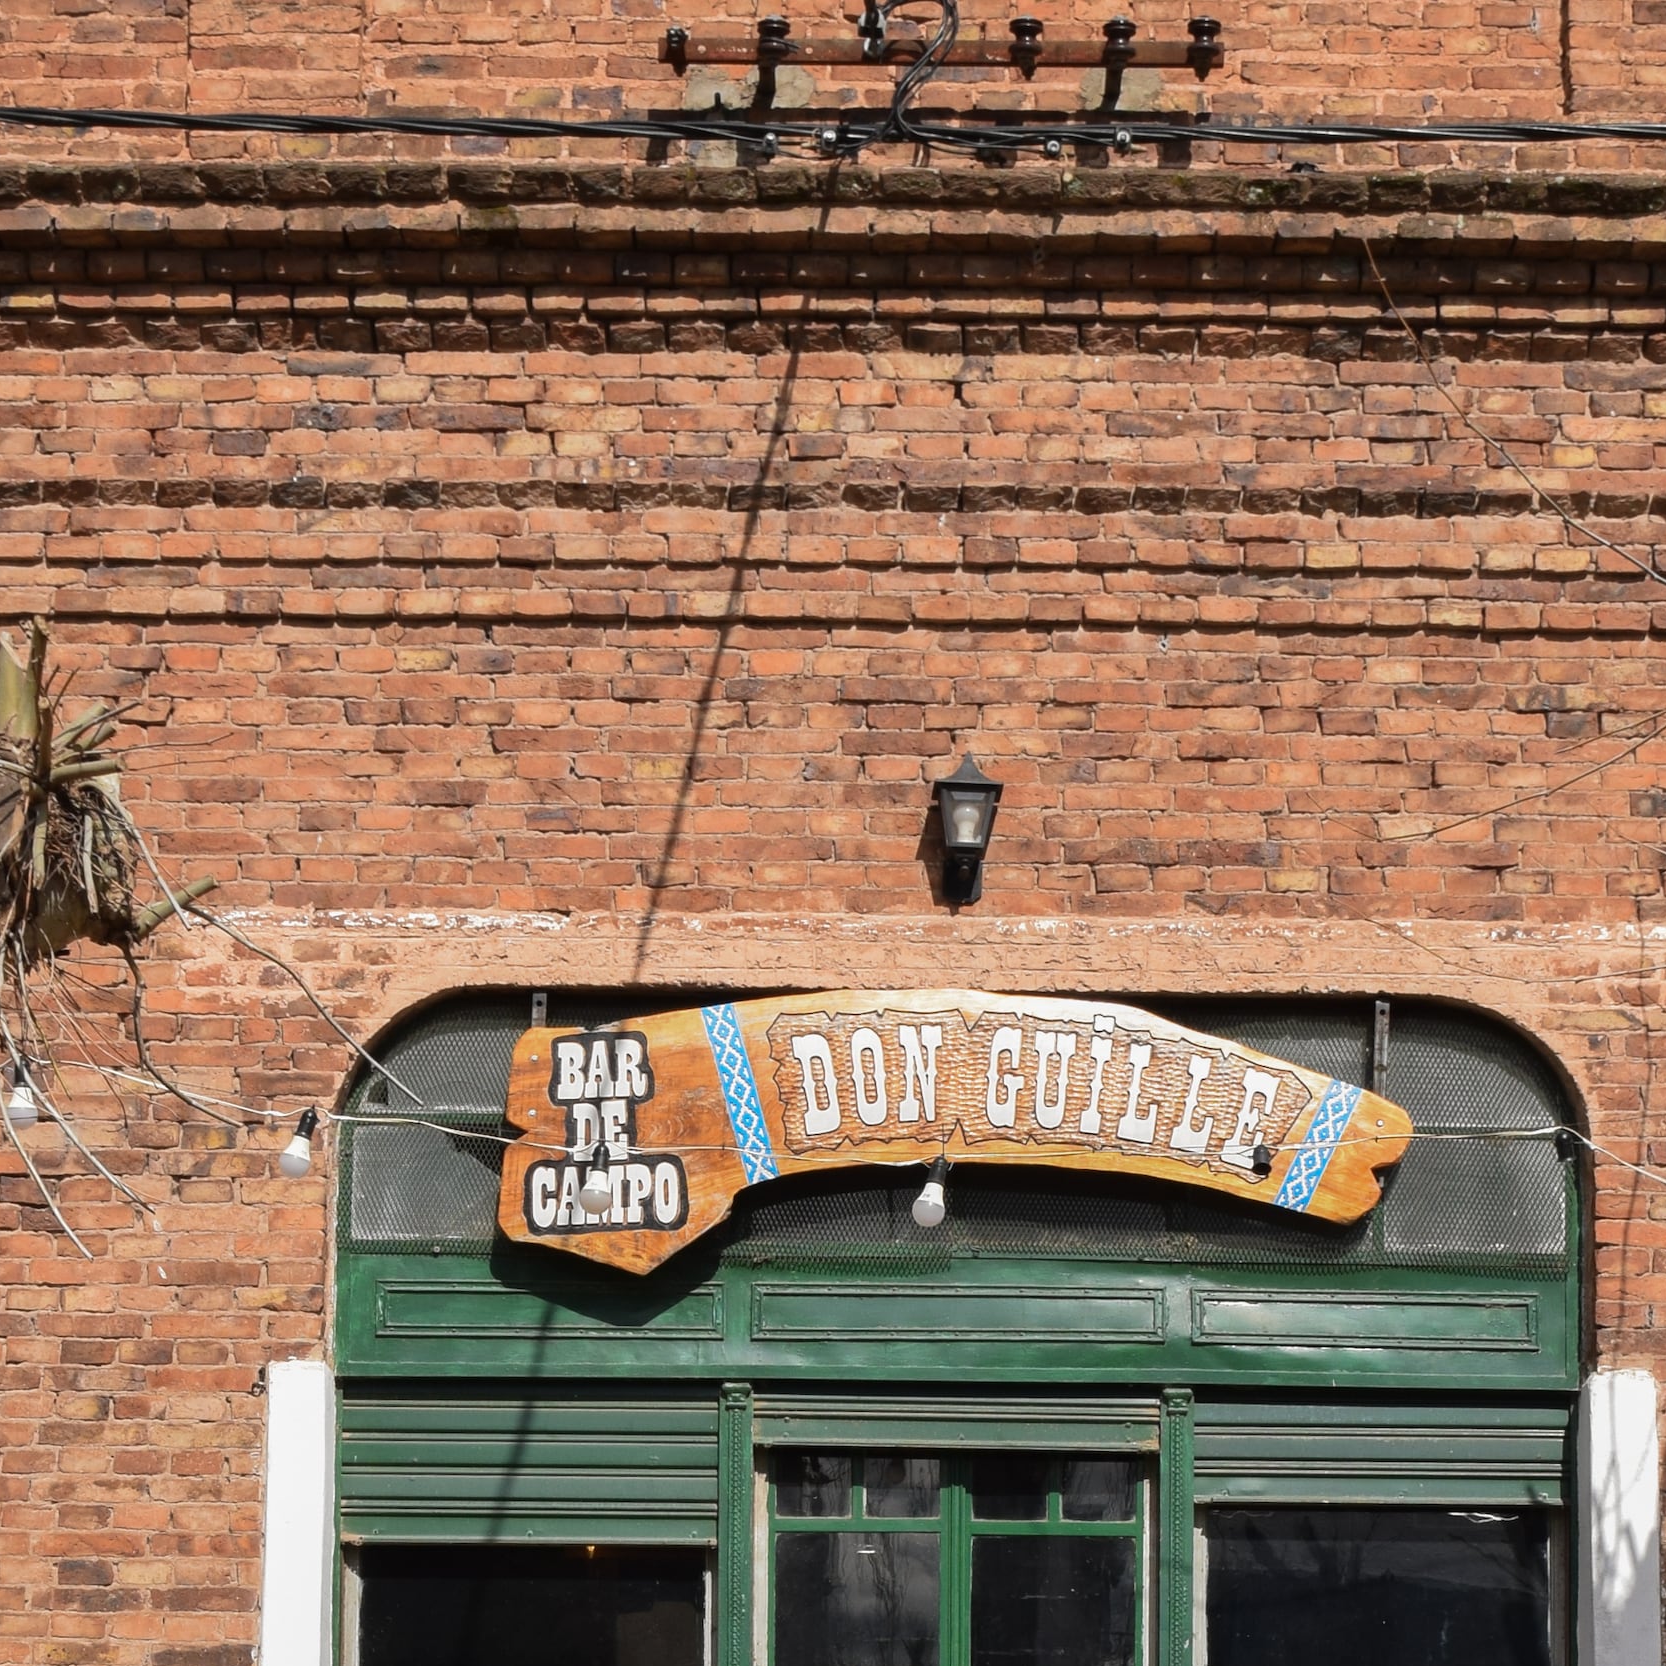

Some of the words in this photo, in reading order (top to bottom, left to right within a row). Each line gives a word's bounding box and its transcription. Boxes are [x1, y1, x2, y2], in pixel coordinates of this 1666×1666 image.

[557, 1039, 649, 1100] BAR
[791, 1024, 943, 1136] DON
[572, 1100, 629, 1162] DE
